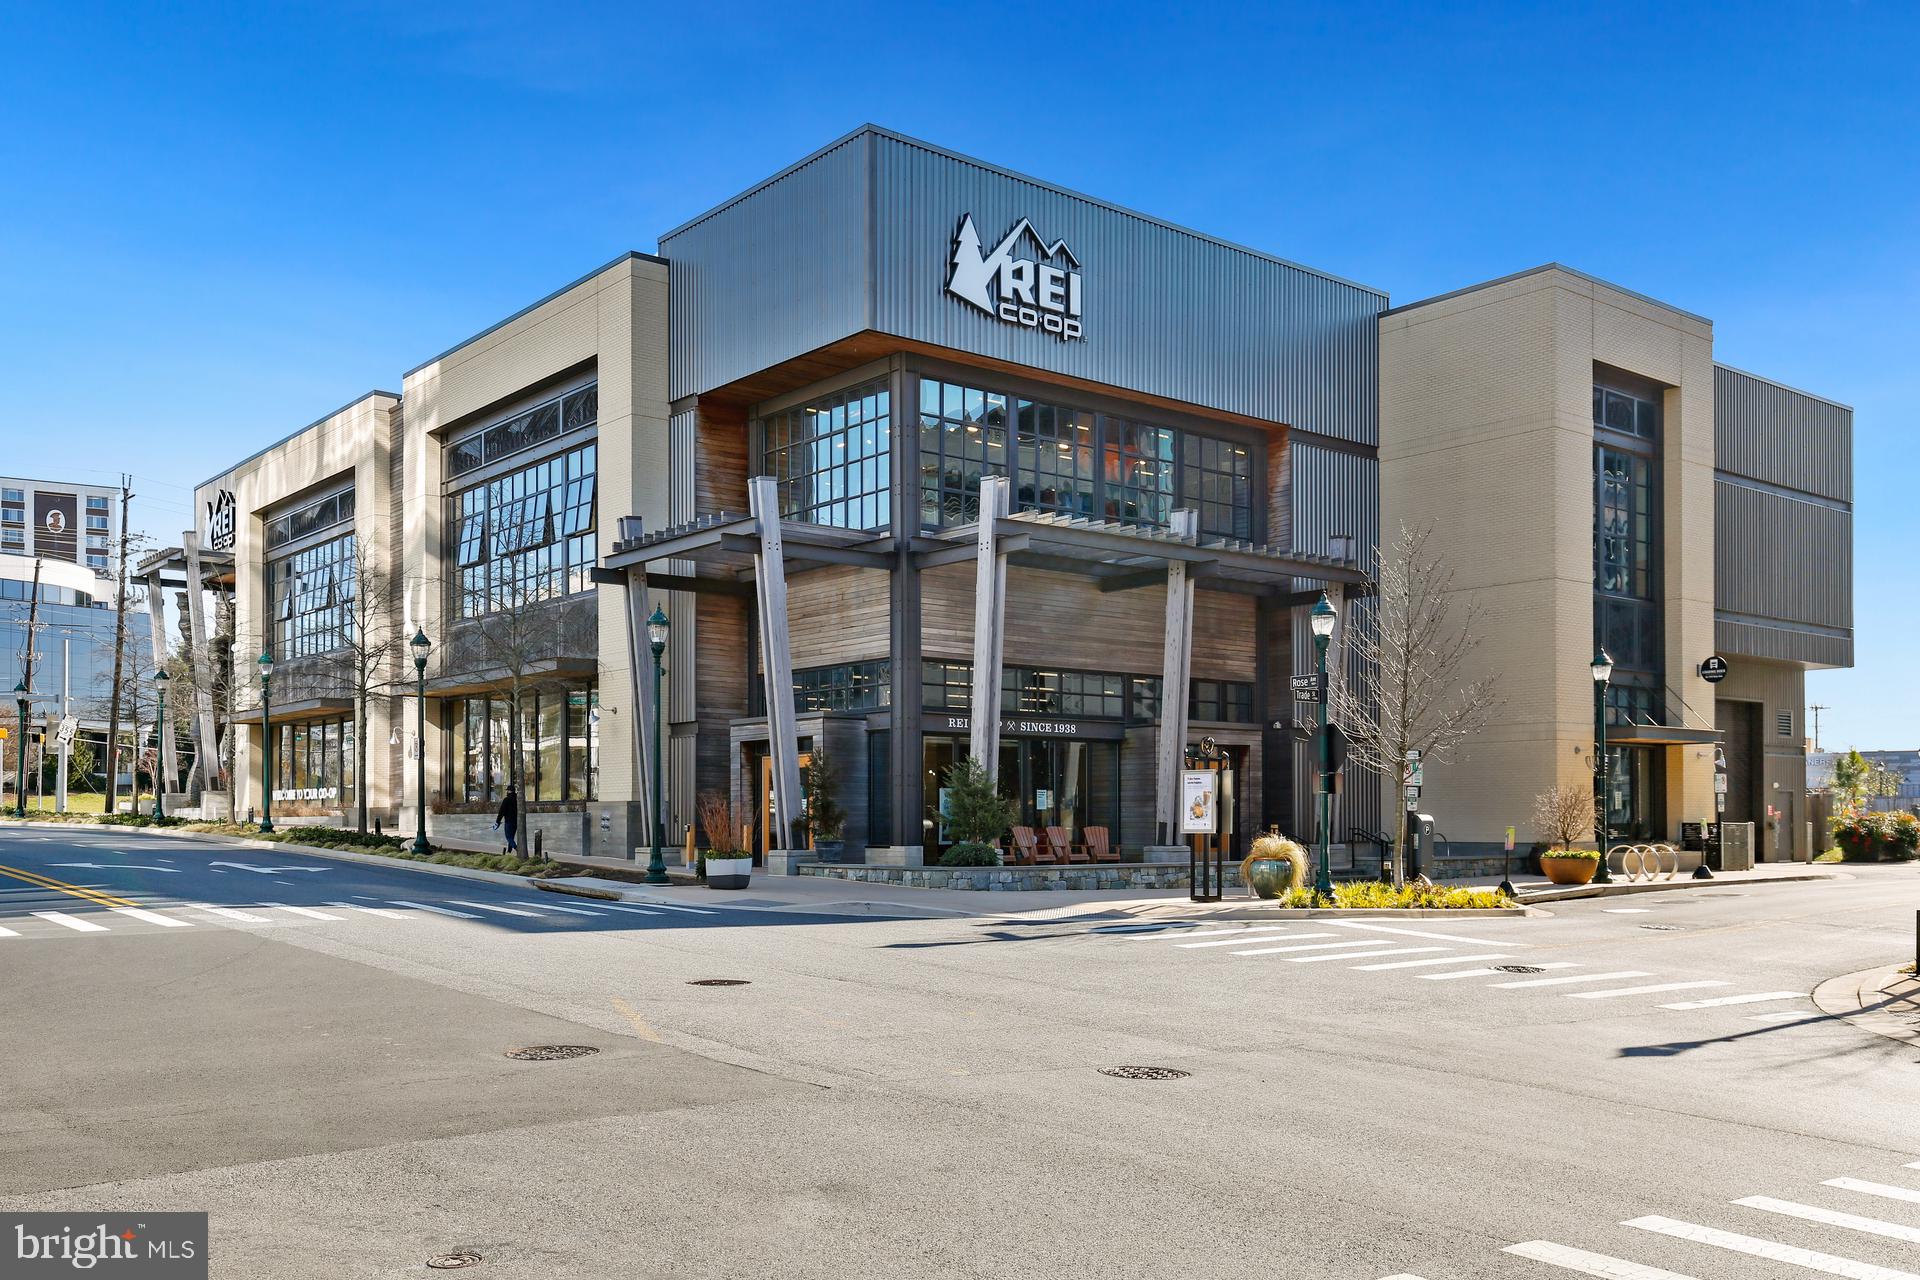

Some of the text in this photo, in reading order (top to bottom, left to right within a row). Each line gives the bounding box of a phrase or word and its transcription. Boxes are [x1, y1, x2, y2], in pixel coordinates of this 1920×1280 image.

[999, 254, 1081, 317] REI
[213, 508, 233, 538] REI
[1292, 678, 1309, 688] Rose
[1296, 690, 1311, 700] Trade
[948, 718, 1077, 734] REI SINCE 1938
[272, 787, 337, 800] WELCOME TO YOUR CO-OP
